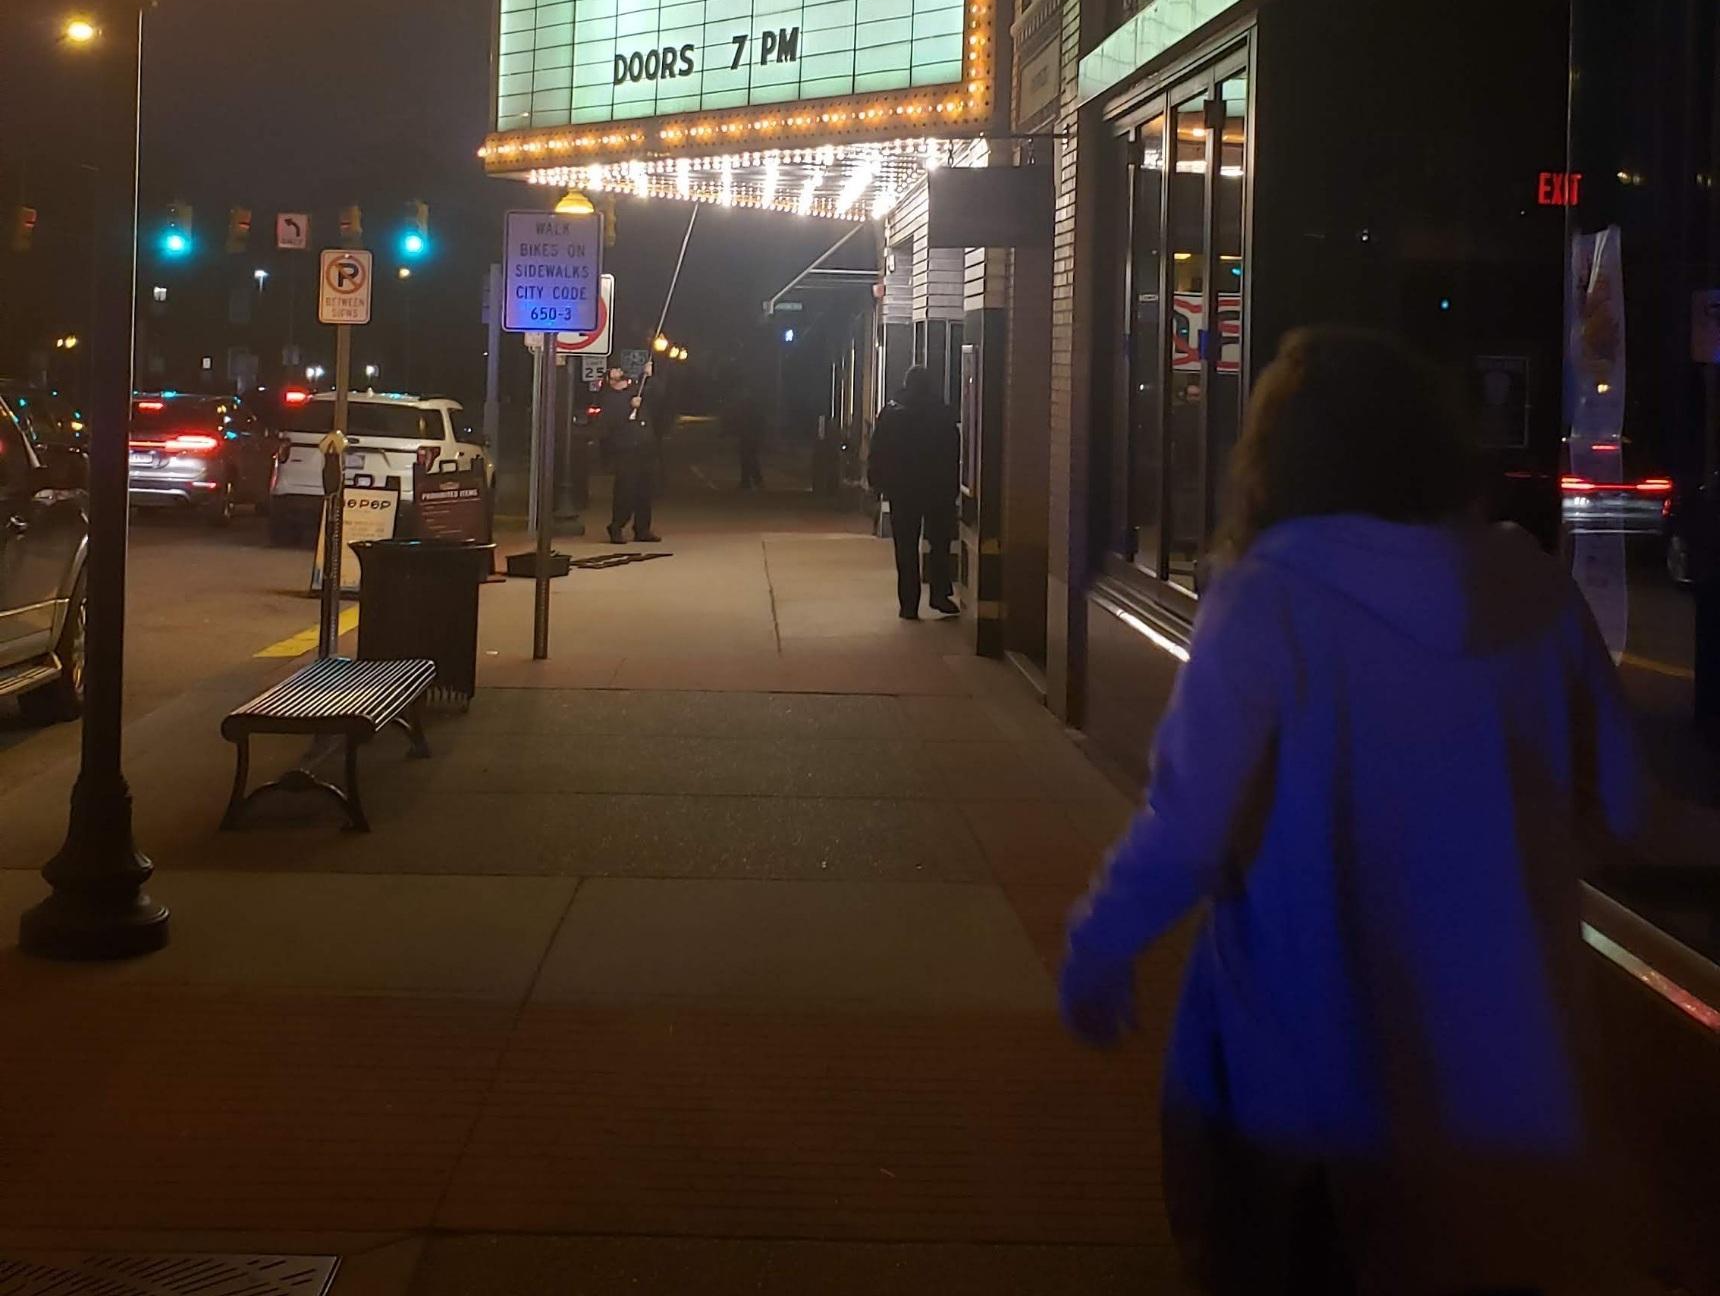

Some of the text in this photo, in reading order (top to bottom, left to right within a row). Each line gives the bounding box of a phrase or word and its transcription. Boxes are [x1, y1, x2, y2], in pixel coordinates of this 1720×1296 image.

[613, 27, 799, 85] DOORS 7 PM
[1539, 172, 1582, 205] EXIT
[536, 222, 571, 235] WALK
[520, 243, 585, 257] BIKES ON
[515, 264, 589, 279] SIDEWALKS
[516, 285, 587, 301] CITY CODE
[530, 307, 572, 321] 650-3
